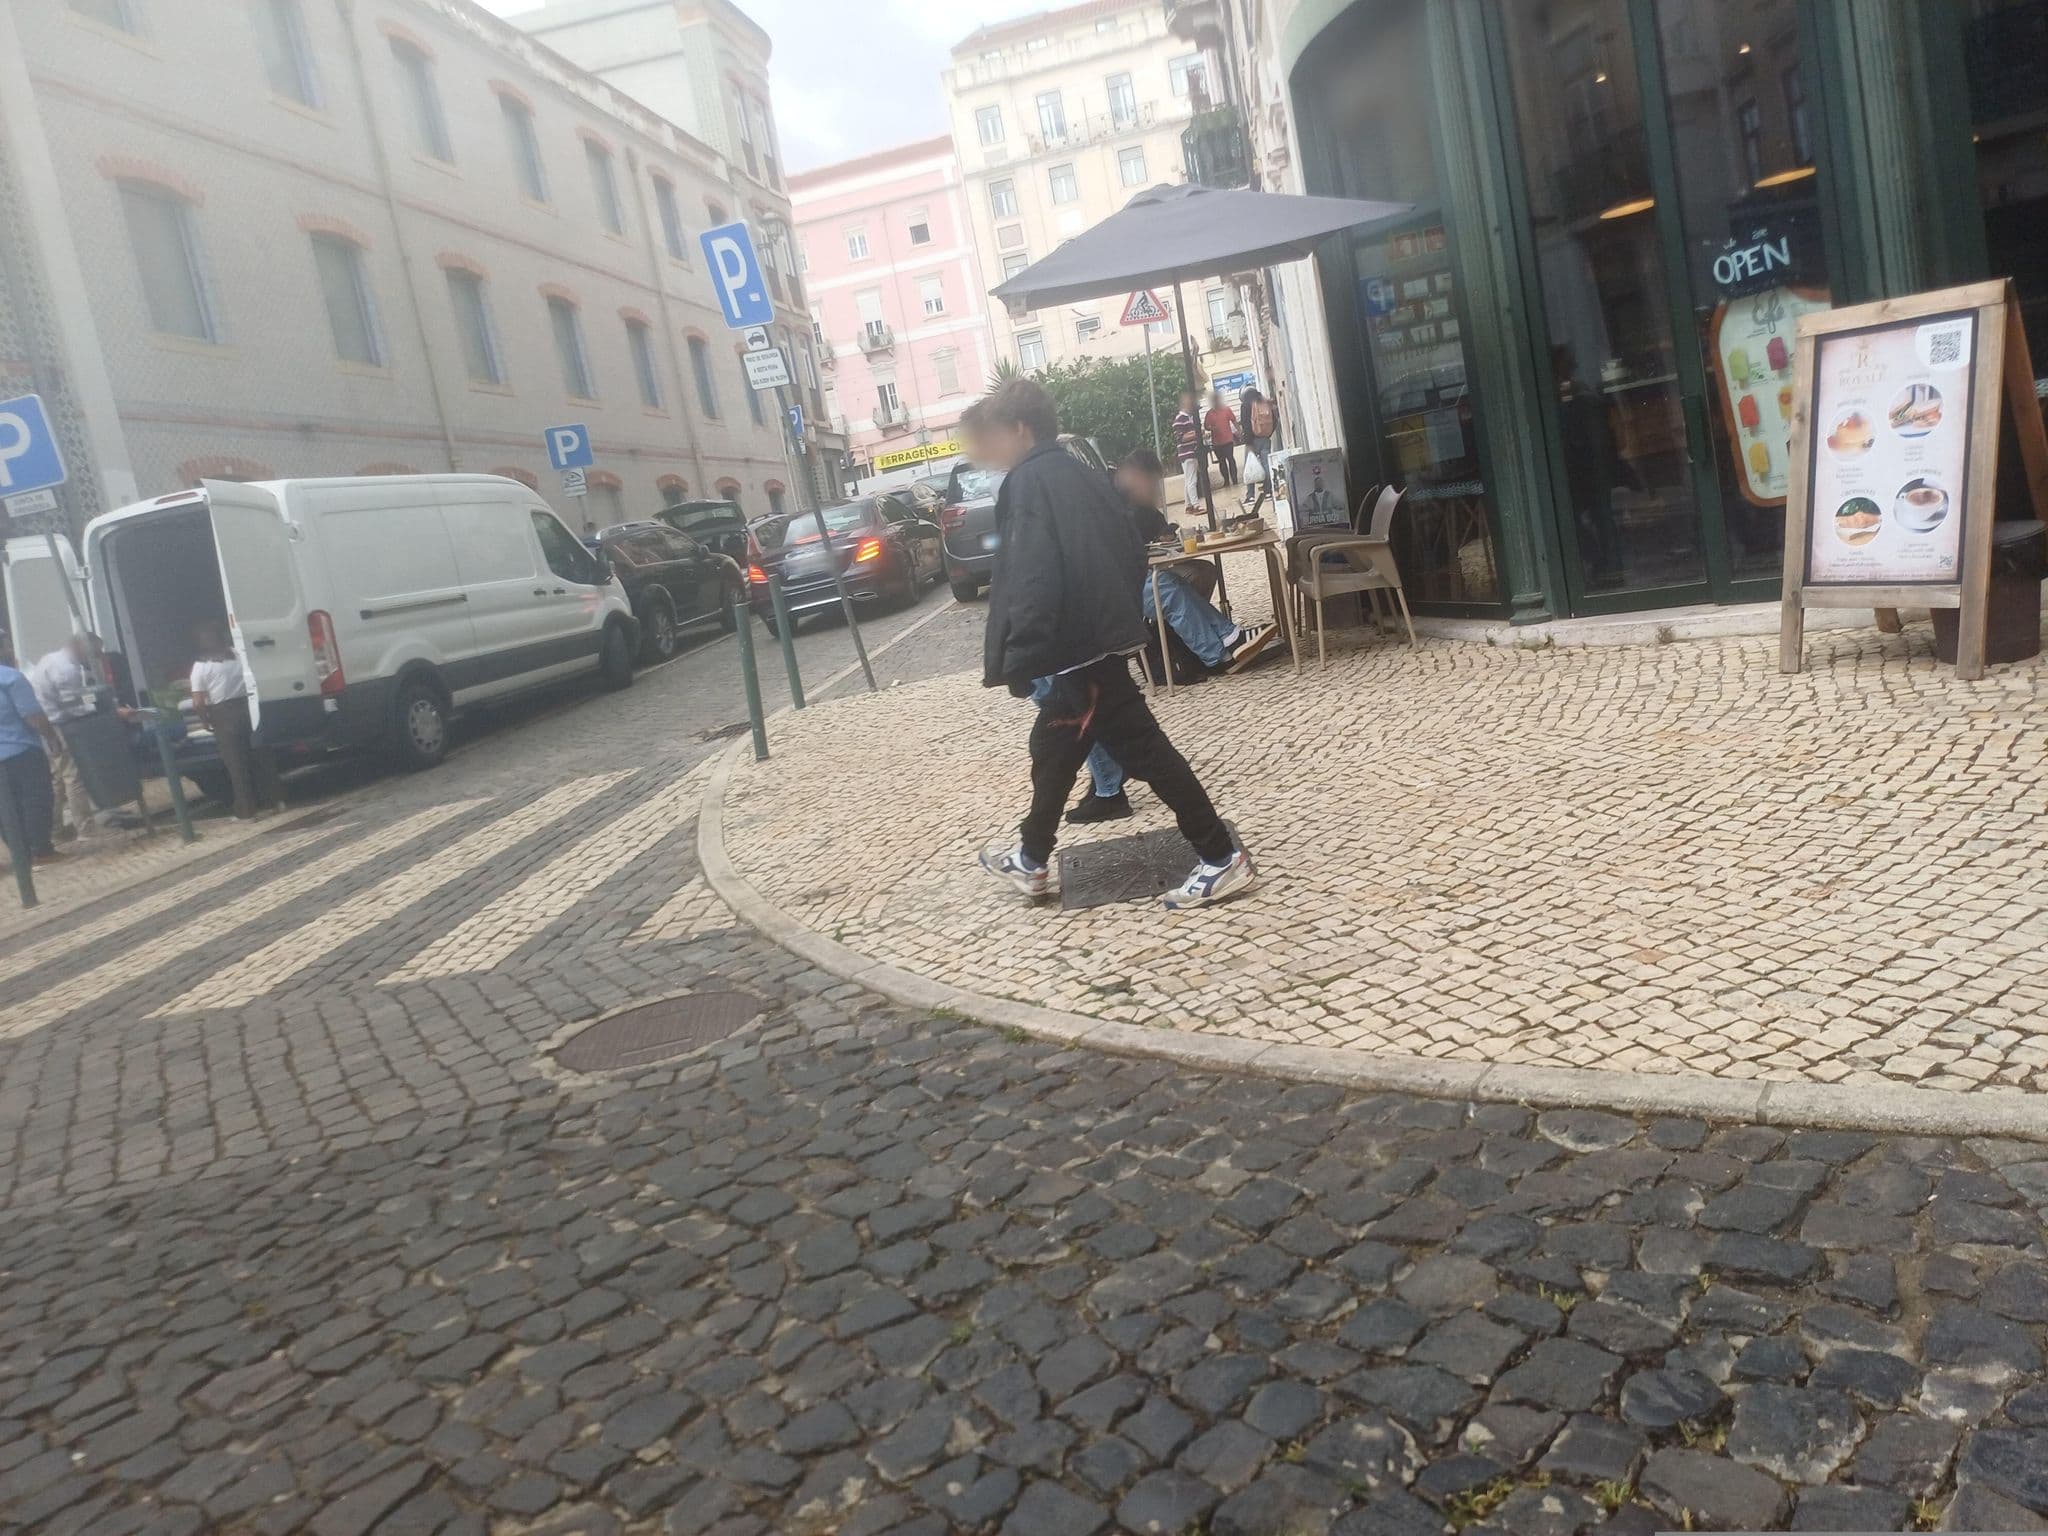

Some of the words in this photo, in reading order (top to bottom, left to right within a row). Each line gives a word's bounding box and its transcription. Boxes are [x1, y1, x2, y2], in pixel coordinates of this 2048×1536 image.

[710, 236, 748, 319] P
[1713, 236, 1791, 285] OPEN
[554, 430, 580, 466] P
